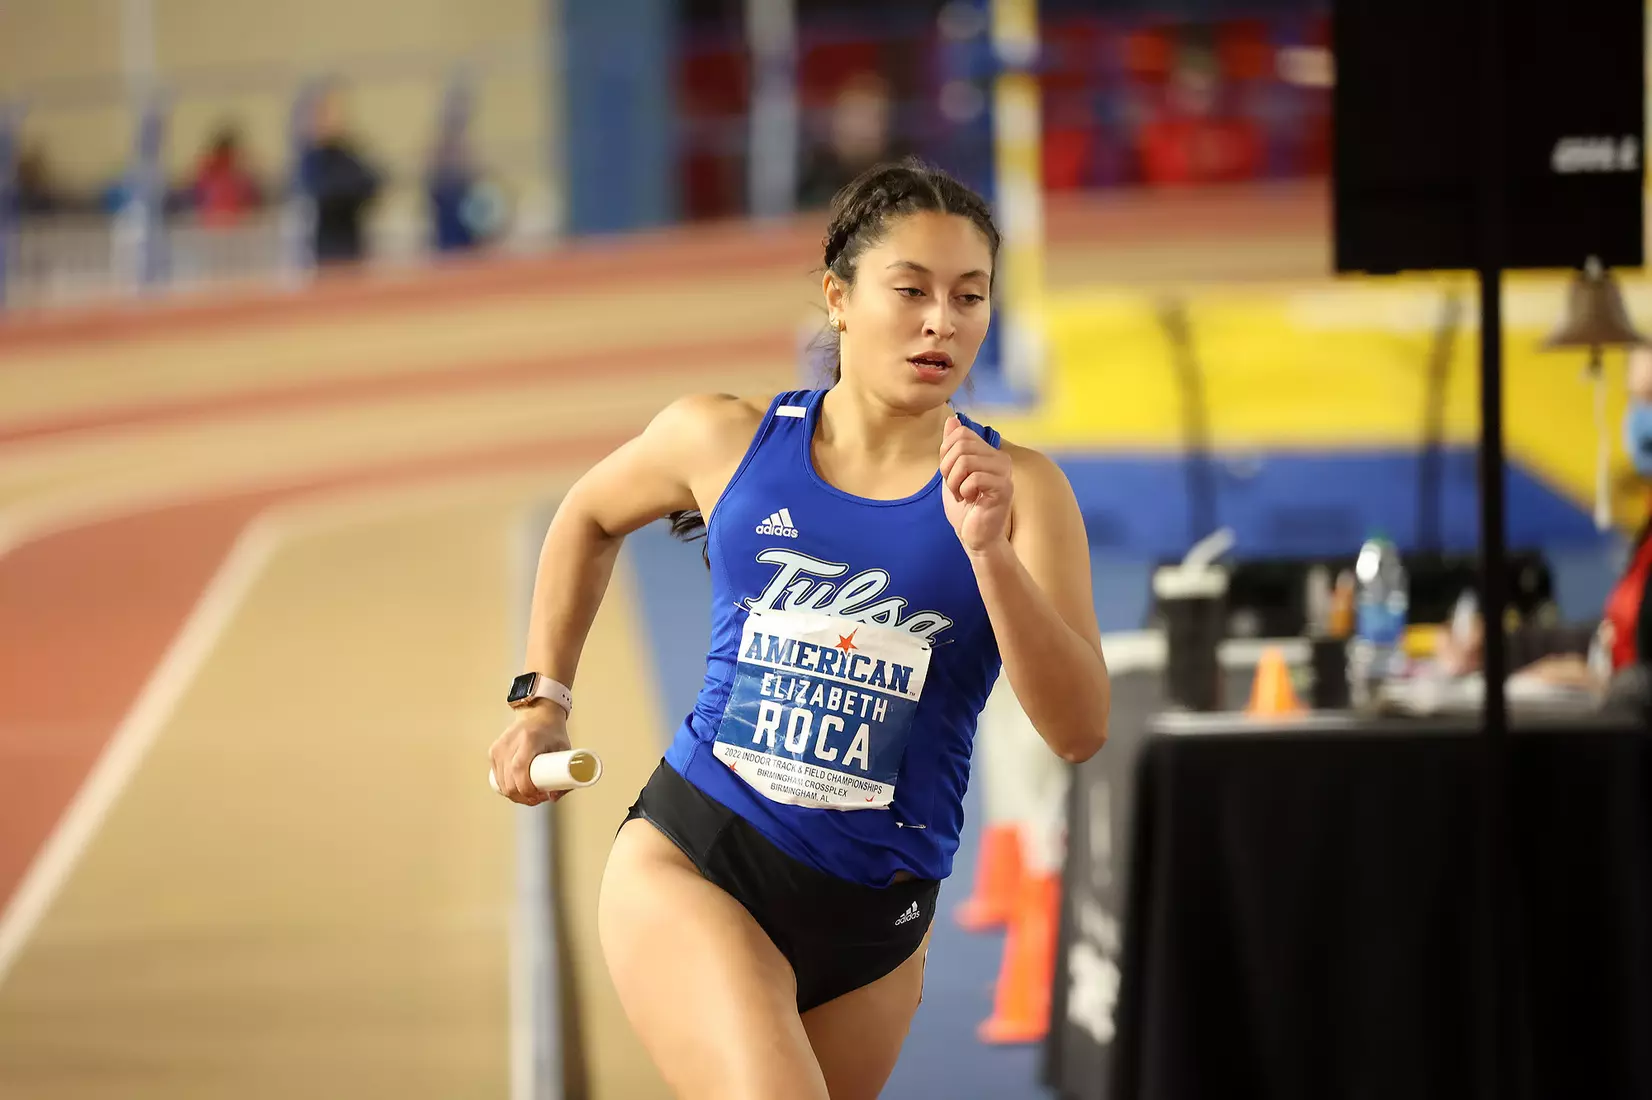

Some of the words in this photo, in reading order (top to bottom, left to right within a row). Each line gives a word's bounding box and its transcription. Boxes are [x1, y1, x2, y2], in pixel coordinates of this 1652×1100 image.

[755, 523, 799, 539] adidas
[744, 547, 954, 644] Tulsa
[744, 632, 914, 694] AMERICAN
[759, 671, 889, 723] ELIZABETH
[752, 699, 871, 771] ROCA
[724, 747, 742, 759] 2022
[741, 752, 772, 767] INDOOR
[772, 759, 797, 774] TRACK
[797, 765, 803, 774] &
[804, 766, 826, 780] FIELD
[826, 772, 883, 795] CHAMPIONSHIPS
[757, 768, 804, 786] BIRMINGHAM
[804, 779, 848, 798] CROSSPLEX
[819, 794, 830, 803] AL
[894, 910, 920, 926] adidas
